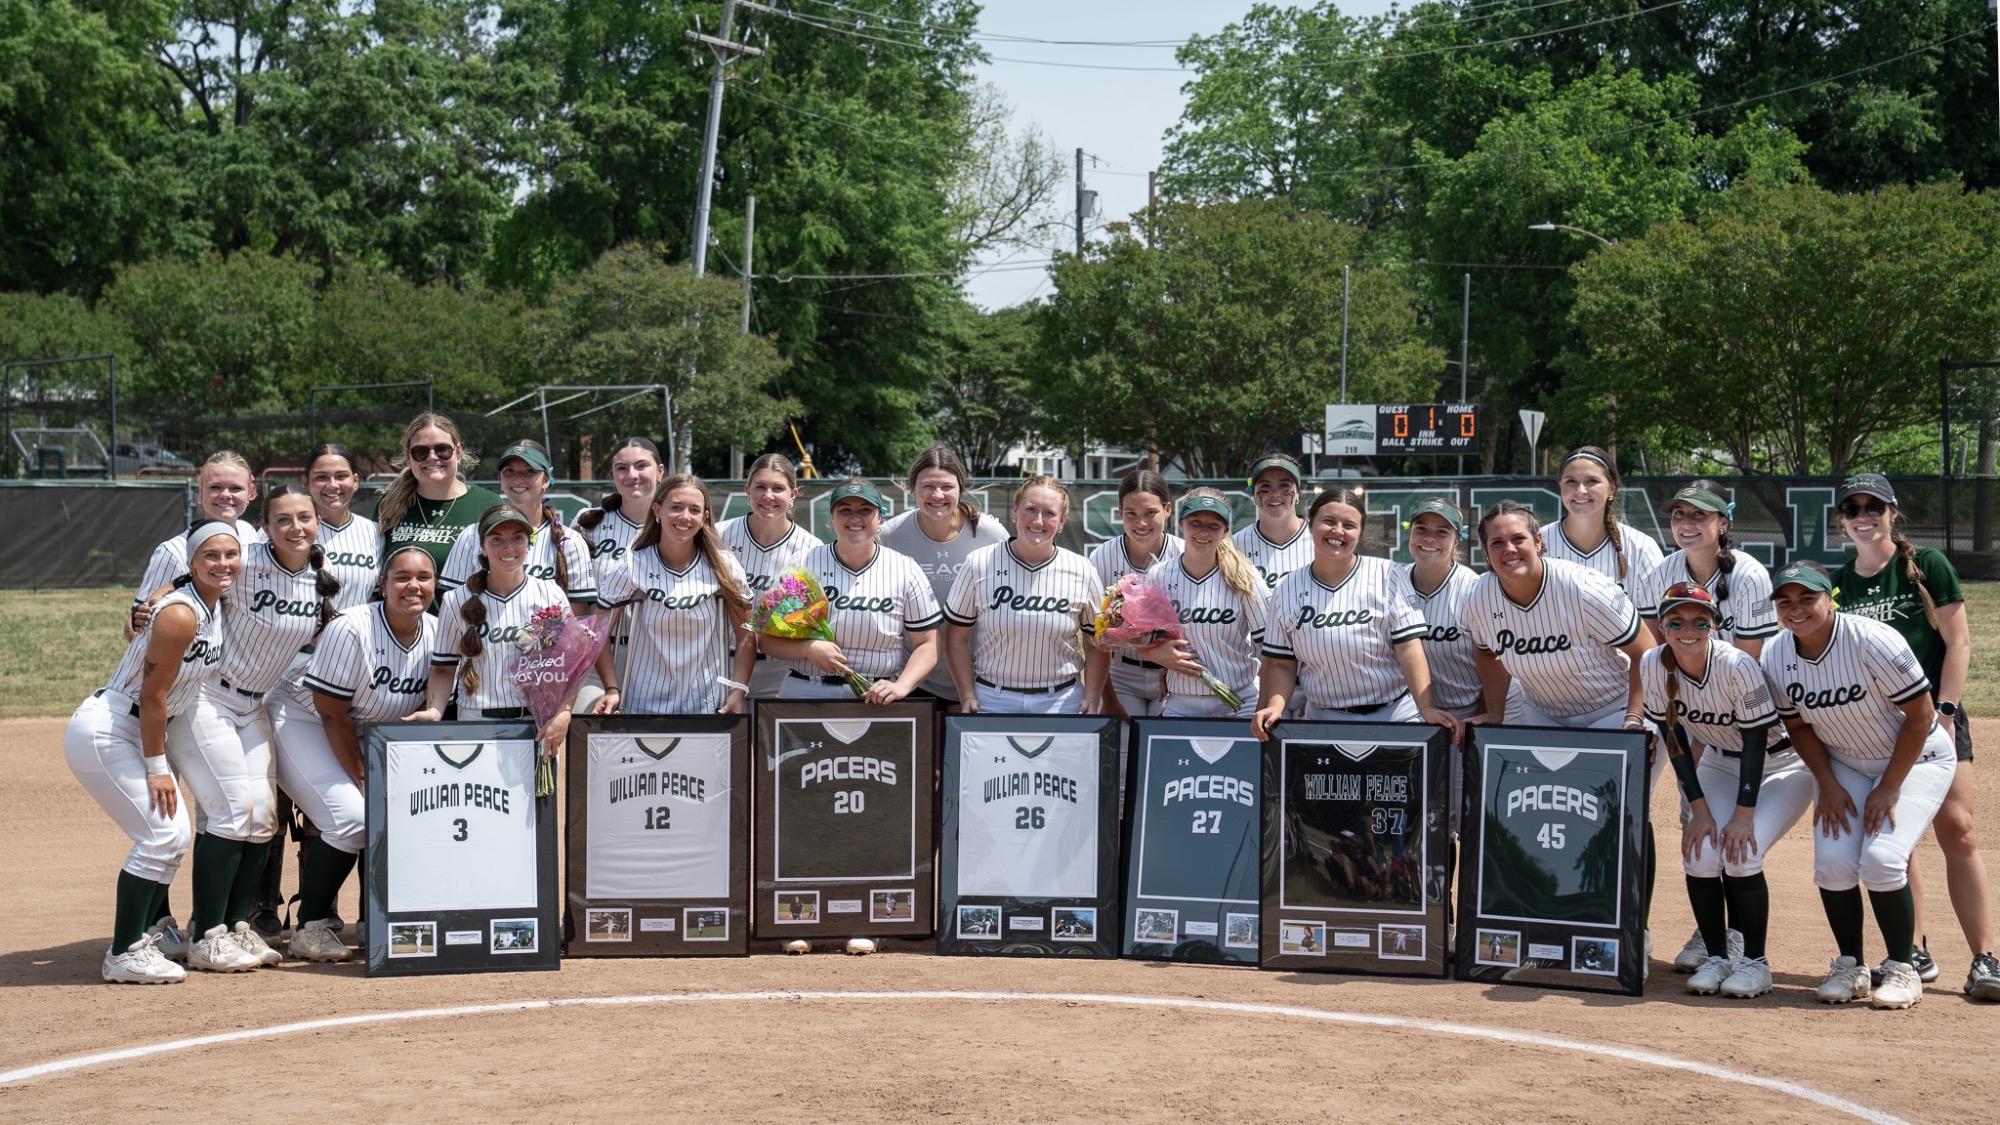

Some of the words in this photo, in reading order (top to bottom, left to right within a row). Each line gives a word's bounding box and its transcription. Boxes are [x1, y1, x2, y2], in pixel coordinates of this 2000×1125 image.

[1379, 405, 1409, 414] GUEST
[1429, 407, 1435, 430] 1
[1446, 405, 1474, 414] HOME
[1394, 414, 1408, 437] 0
[1418, 430, 1436, 438] INN
[1461, 414, 1475, 437] 0
[1382, 438, 1406, 446] BALL
[1410, 438, 1444, 446] STRIKE
[1450, 438, 1470, 446] OUT
[391, 526, 454, 536] UNIVERSITY
[391, 534, 450, 544] SOFTBALL
[824, 585, 896, 613] Peace
[989, 585, 1072, 614] Peace
[1295, 605, 1374, 630] Peace
[1495, 629, 1572, 656] Peace
[517, 652, 565, 670] Picked
[535, 671, 569, 686] you.
[1786, 682, 1867, 709] Peace
[801, 756, 897, 789] PACERS
[410, 783, 460, 816] WILLIAM
[464, 782, 510, 815] PEACE
[609, 772, 657, 804] WILLIAM
[661, 771, 705, 803] PEACE
[984, 772, 1030, 803] WILLIAM
[1034, 772, 1077, 804] PEACE
[1163, 774, 1254, 807] PACERS
[1304, 773, 1361, 801] WILLIAM
[1366, 774, 1408, 803] PEACE
[834, 790, 865, 814] 20
[1507, 784, 1599, 822] PACERS
[453, 818, 468, 842] 3
[645, 806, 671, 830] 12
[1015, 806, 1045, 830] 26
[1191, 810, 1222, 834] 27
[1371, 807, 1405, 835] 37
[1536, 822, 1566, 850] 45
